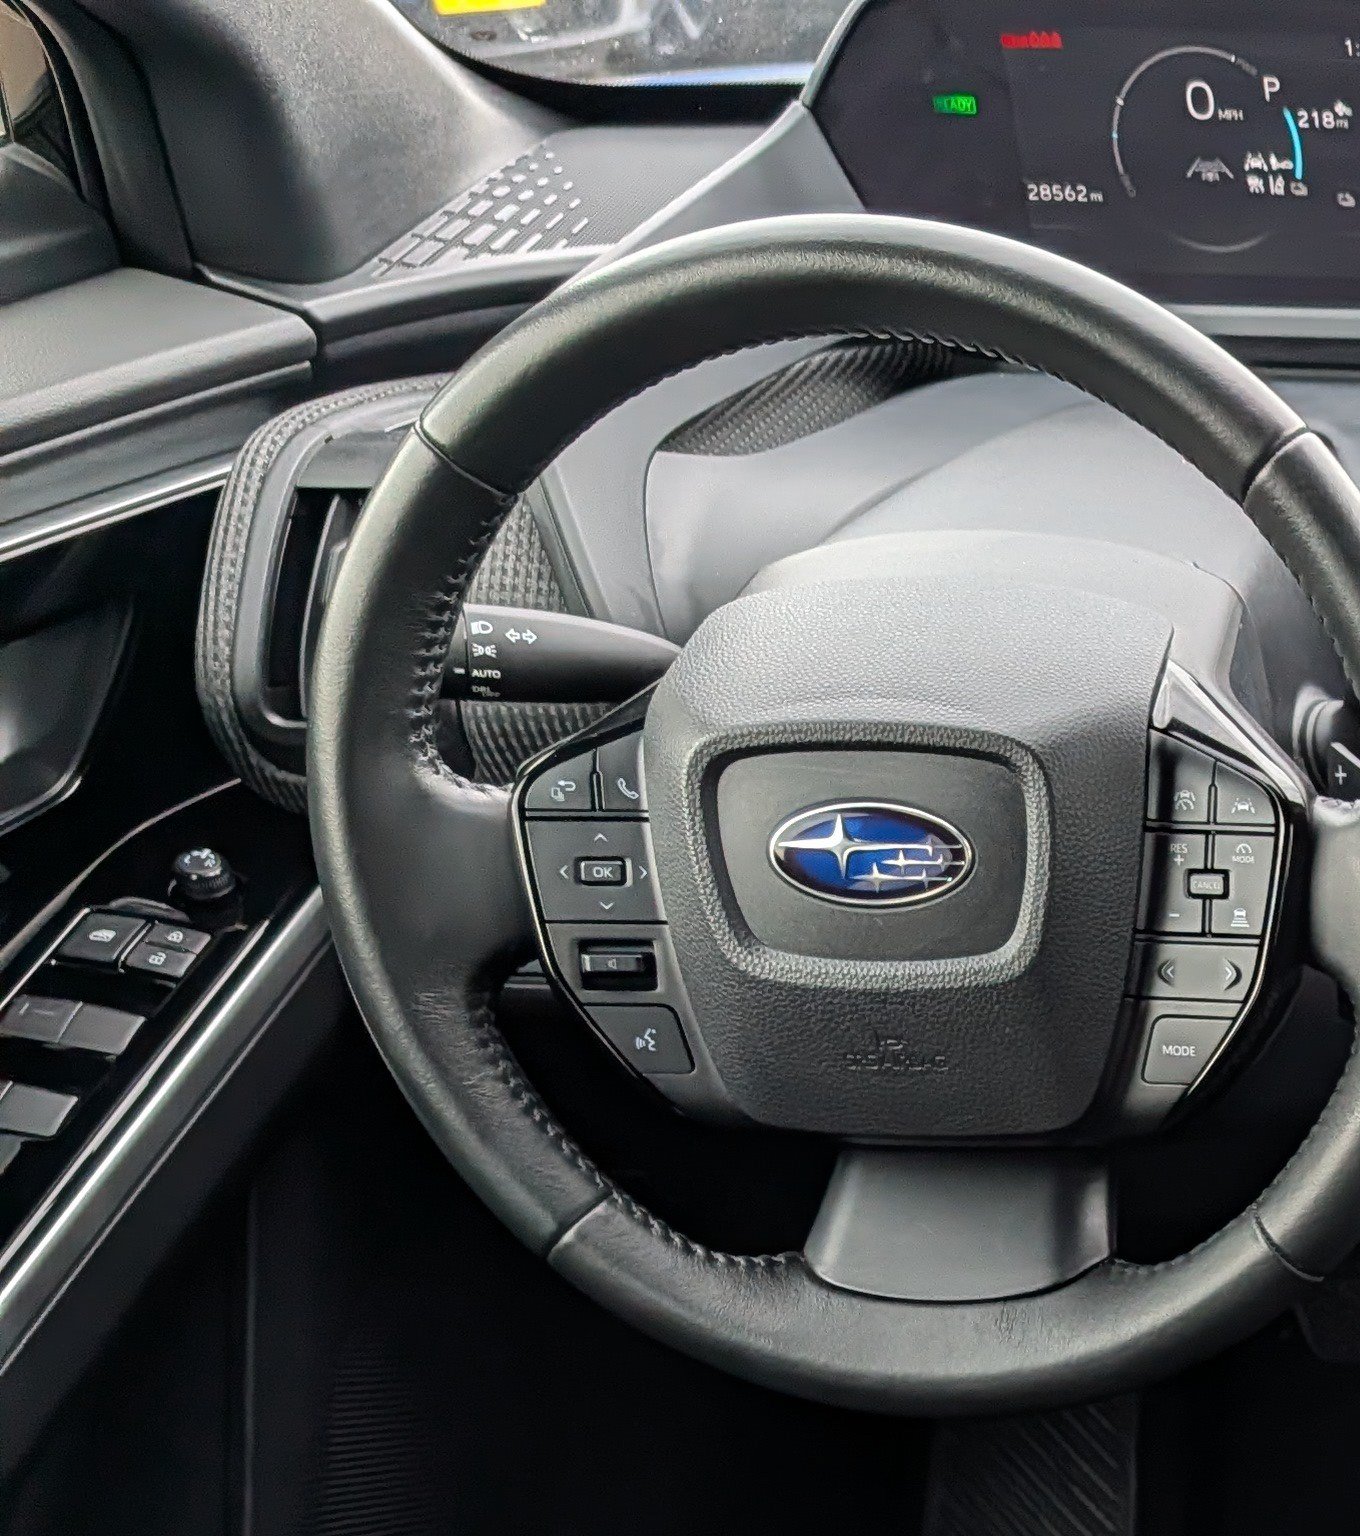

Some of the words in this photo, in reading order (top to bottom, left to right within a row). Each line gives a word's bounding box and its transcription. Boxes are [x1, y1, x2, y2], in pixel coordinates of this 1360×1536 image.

[1262, 75, 1280, 102] P
[1186, 80, 1214, 120] 0
[1218, 109, 1243, 121] MPH
[1297, 109, 1335, 129] 218
[1027, 183, 1087, 202] 28562
[471, 668, 502, 680] AUTO
[1170, 843, 1188, 854] RES
[593, 866, 614, 878] OK
[1162, 1044, 1196, 1057] MODE
